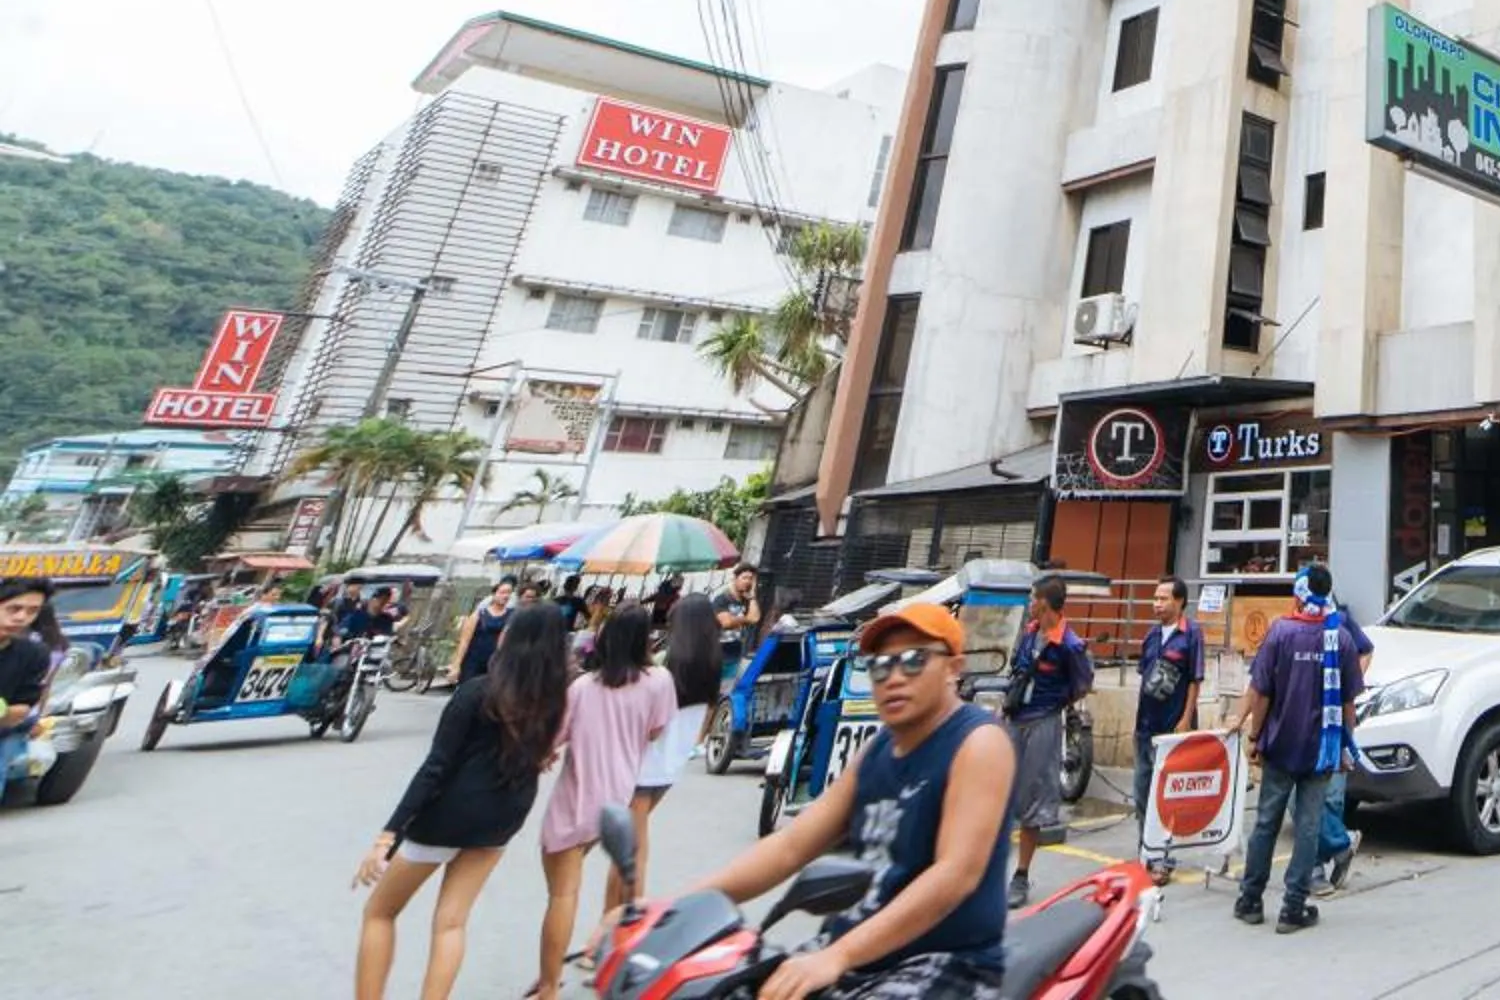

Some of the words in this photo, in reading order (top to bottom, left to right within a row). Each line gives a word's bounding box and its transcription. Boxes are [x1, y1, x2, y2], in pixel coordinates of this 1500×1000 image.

[1395, 15, 1466, 61] OLONGAPO
[629, 112, 704, 148] WIN
[593, 137, 713, 182] HOTEL
[210, 315, 277, 386] WIN
[156, 393, 268, 421] HOTEL
[1111, 421, 1144, 461] T
[1211, 430, 1228, 453] T
[1237, 423, 1320, 462] Turks
[239, 666, 296, 699] 3474
[1168, 776, 1184, 793] NO
[1185, 774, 1215, 791] ENTRY
